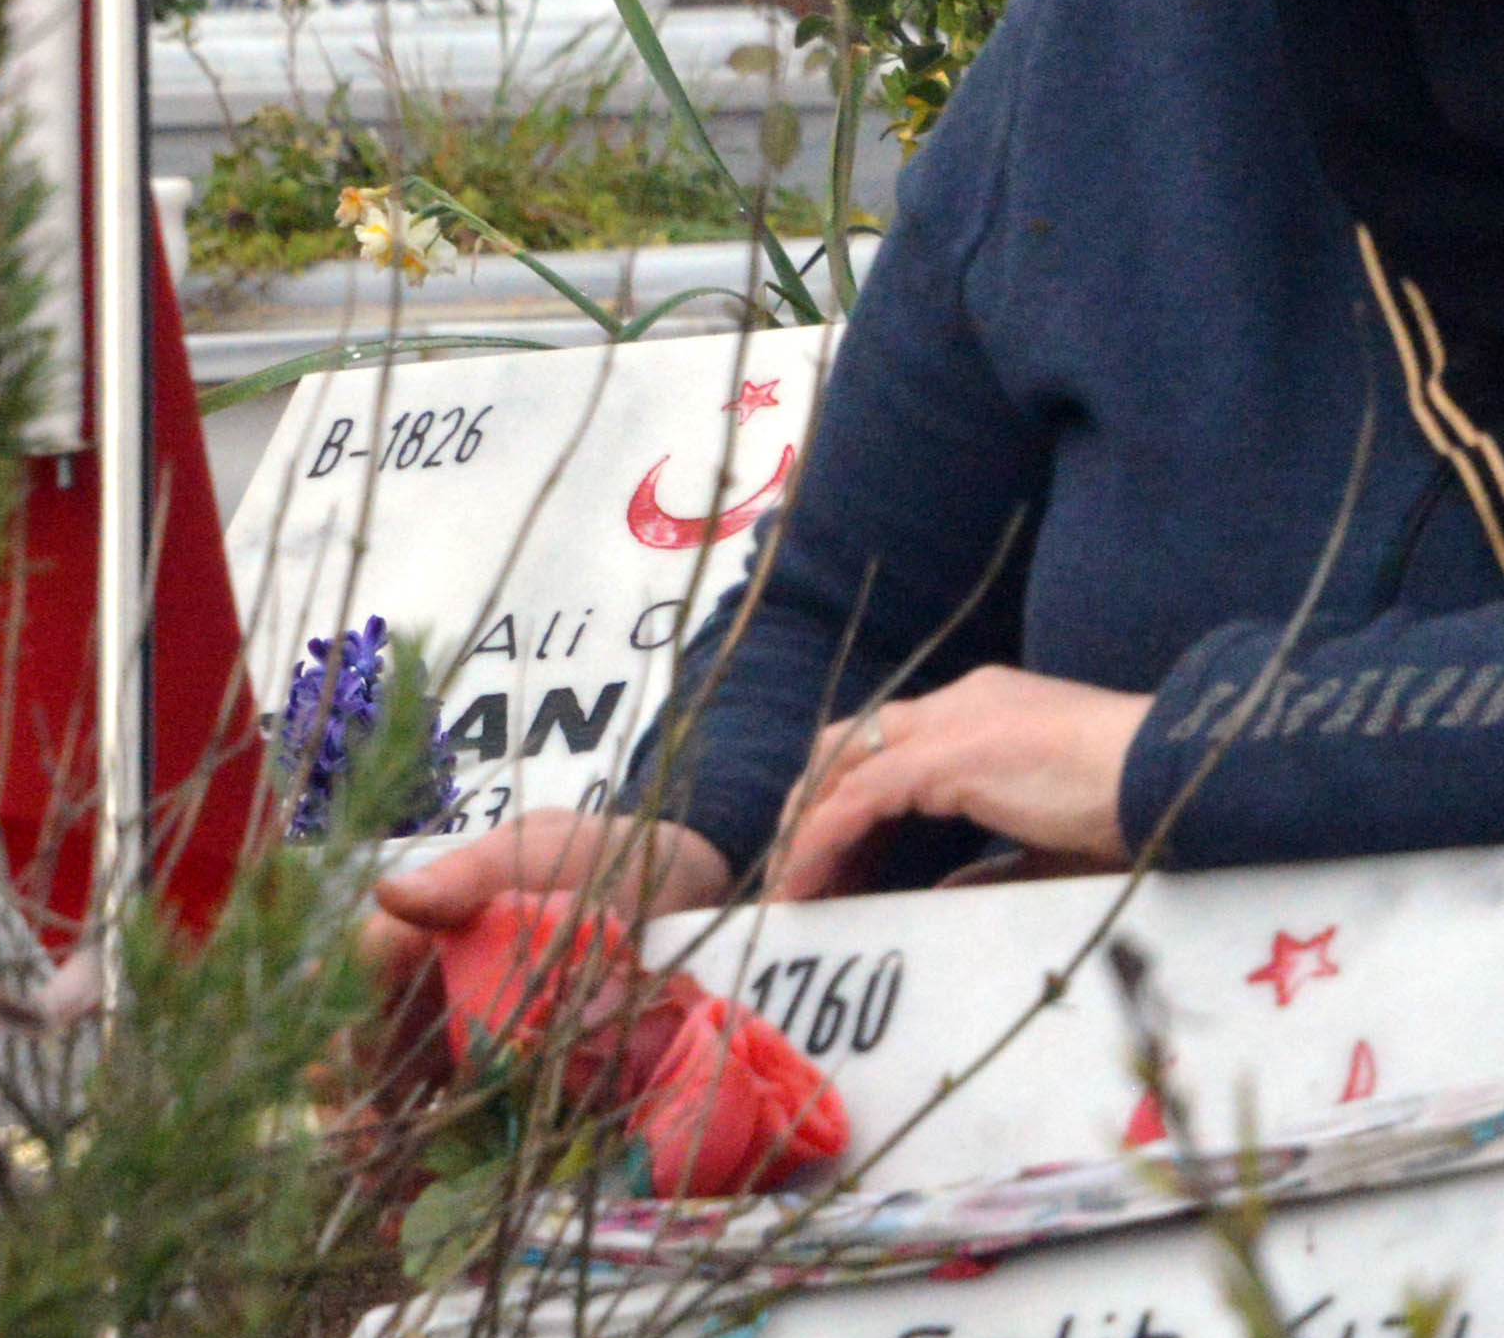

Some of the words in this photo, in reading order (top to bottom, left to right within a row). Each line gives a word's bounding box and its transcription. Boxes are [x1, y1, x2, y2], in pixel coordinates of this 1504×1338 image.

[304, 405, 494, 479] B-1826
[462, 607, 594, 665] Ali
[751, 947, 905, 1056] 1760
